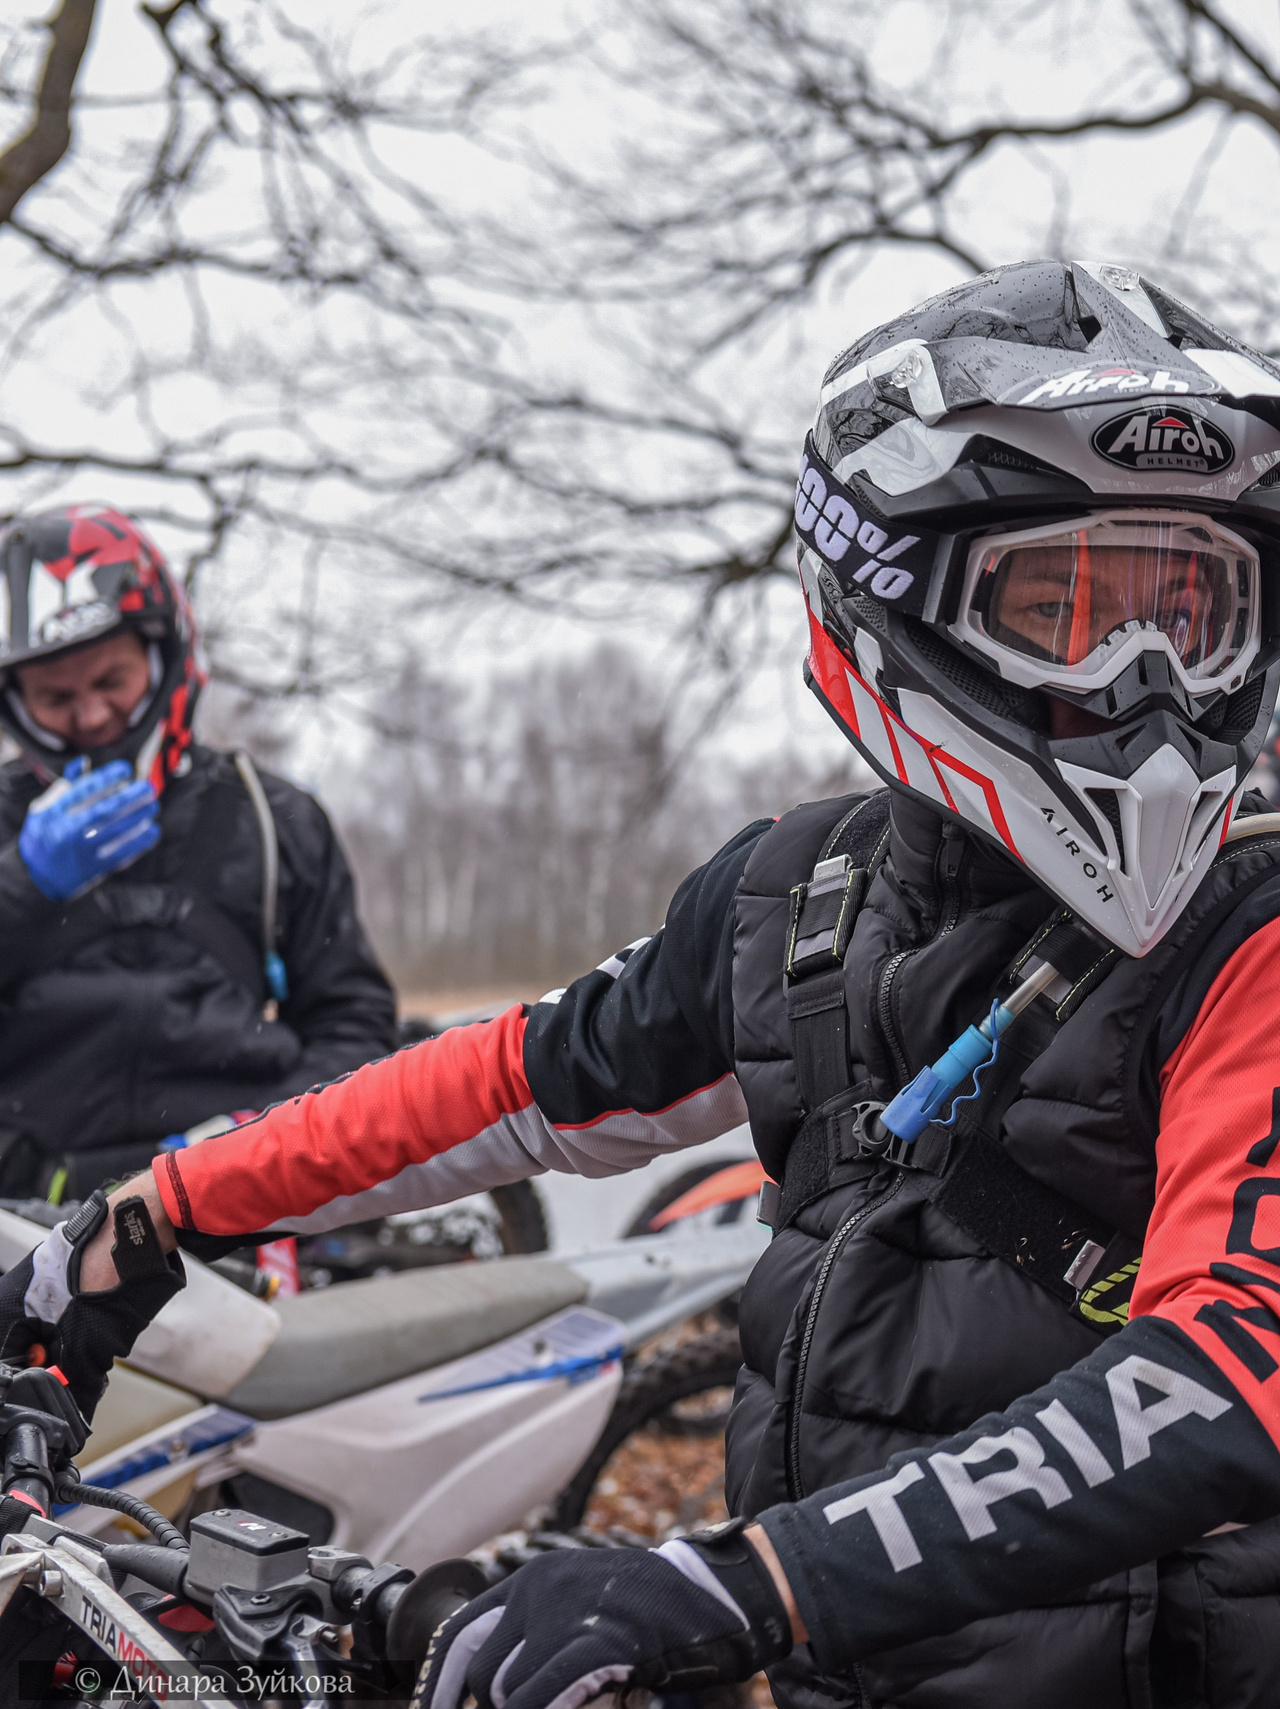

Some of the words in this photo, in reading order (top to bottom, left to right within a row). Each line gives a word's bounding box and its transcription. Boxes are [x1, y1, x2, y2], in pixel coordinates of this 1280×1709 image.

[1017, 369, 1189, 405] Airoh
[1107, 415, 1225, 460] Airoh
[1147, 457, 1200, 468] HELMET
[1040, 807, 1114, 903] AIROH
[822, 1354, 1233, 1573] TRIA
